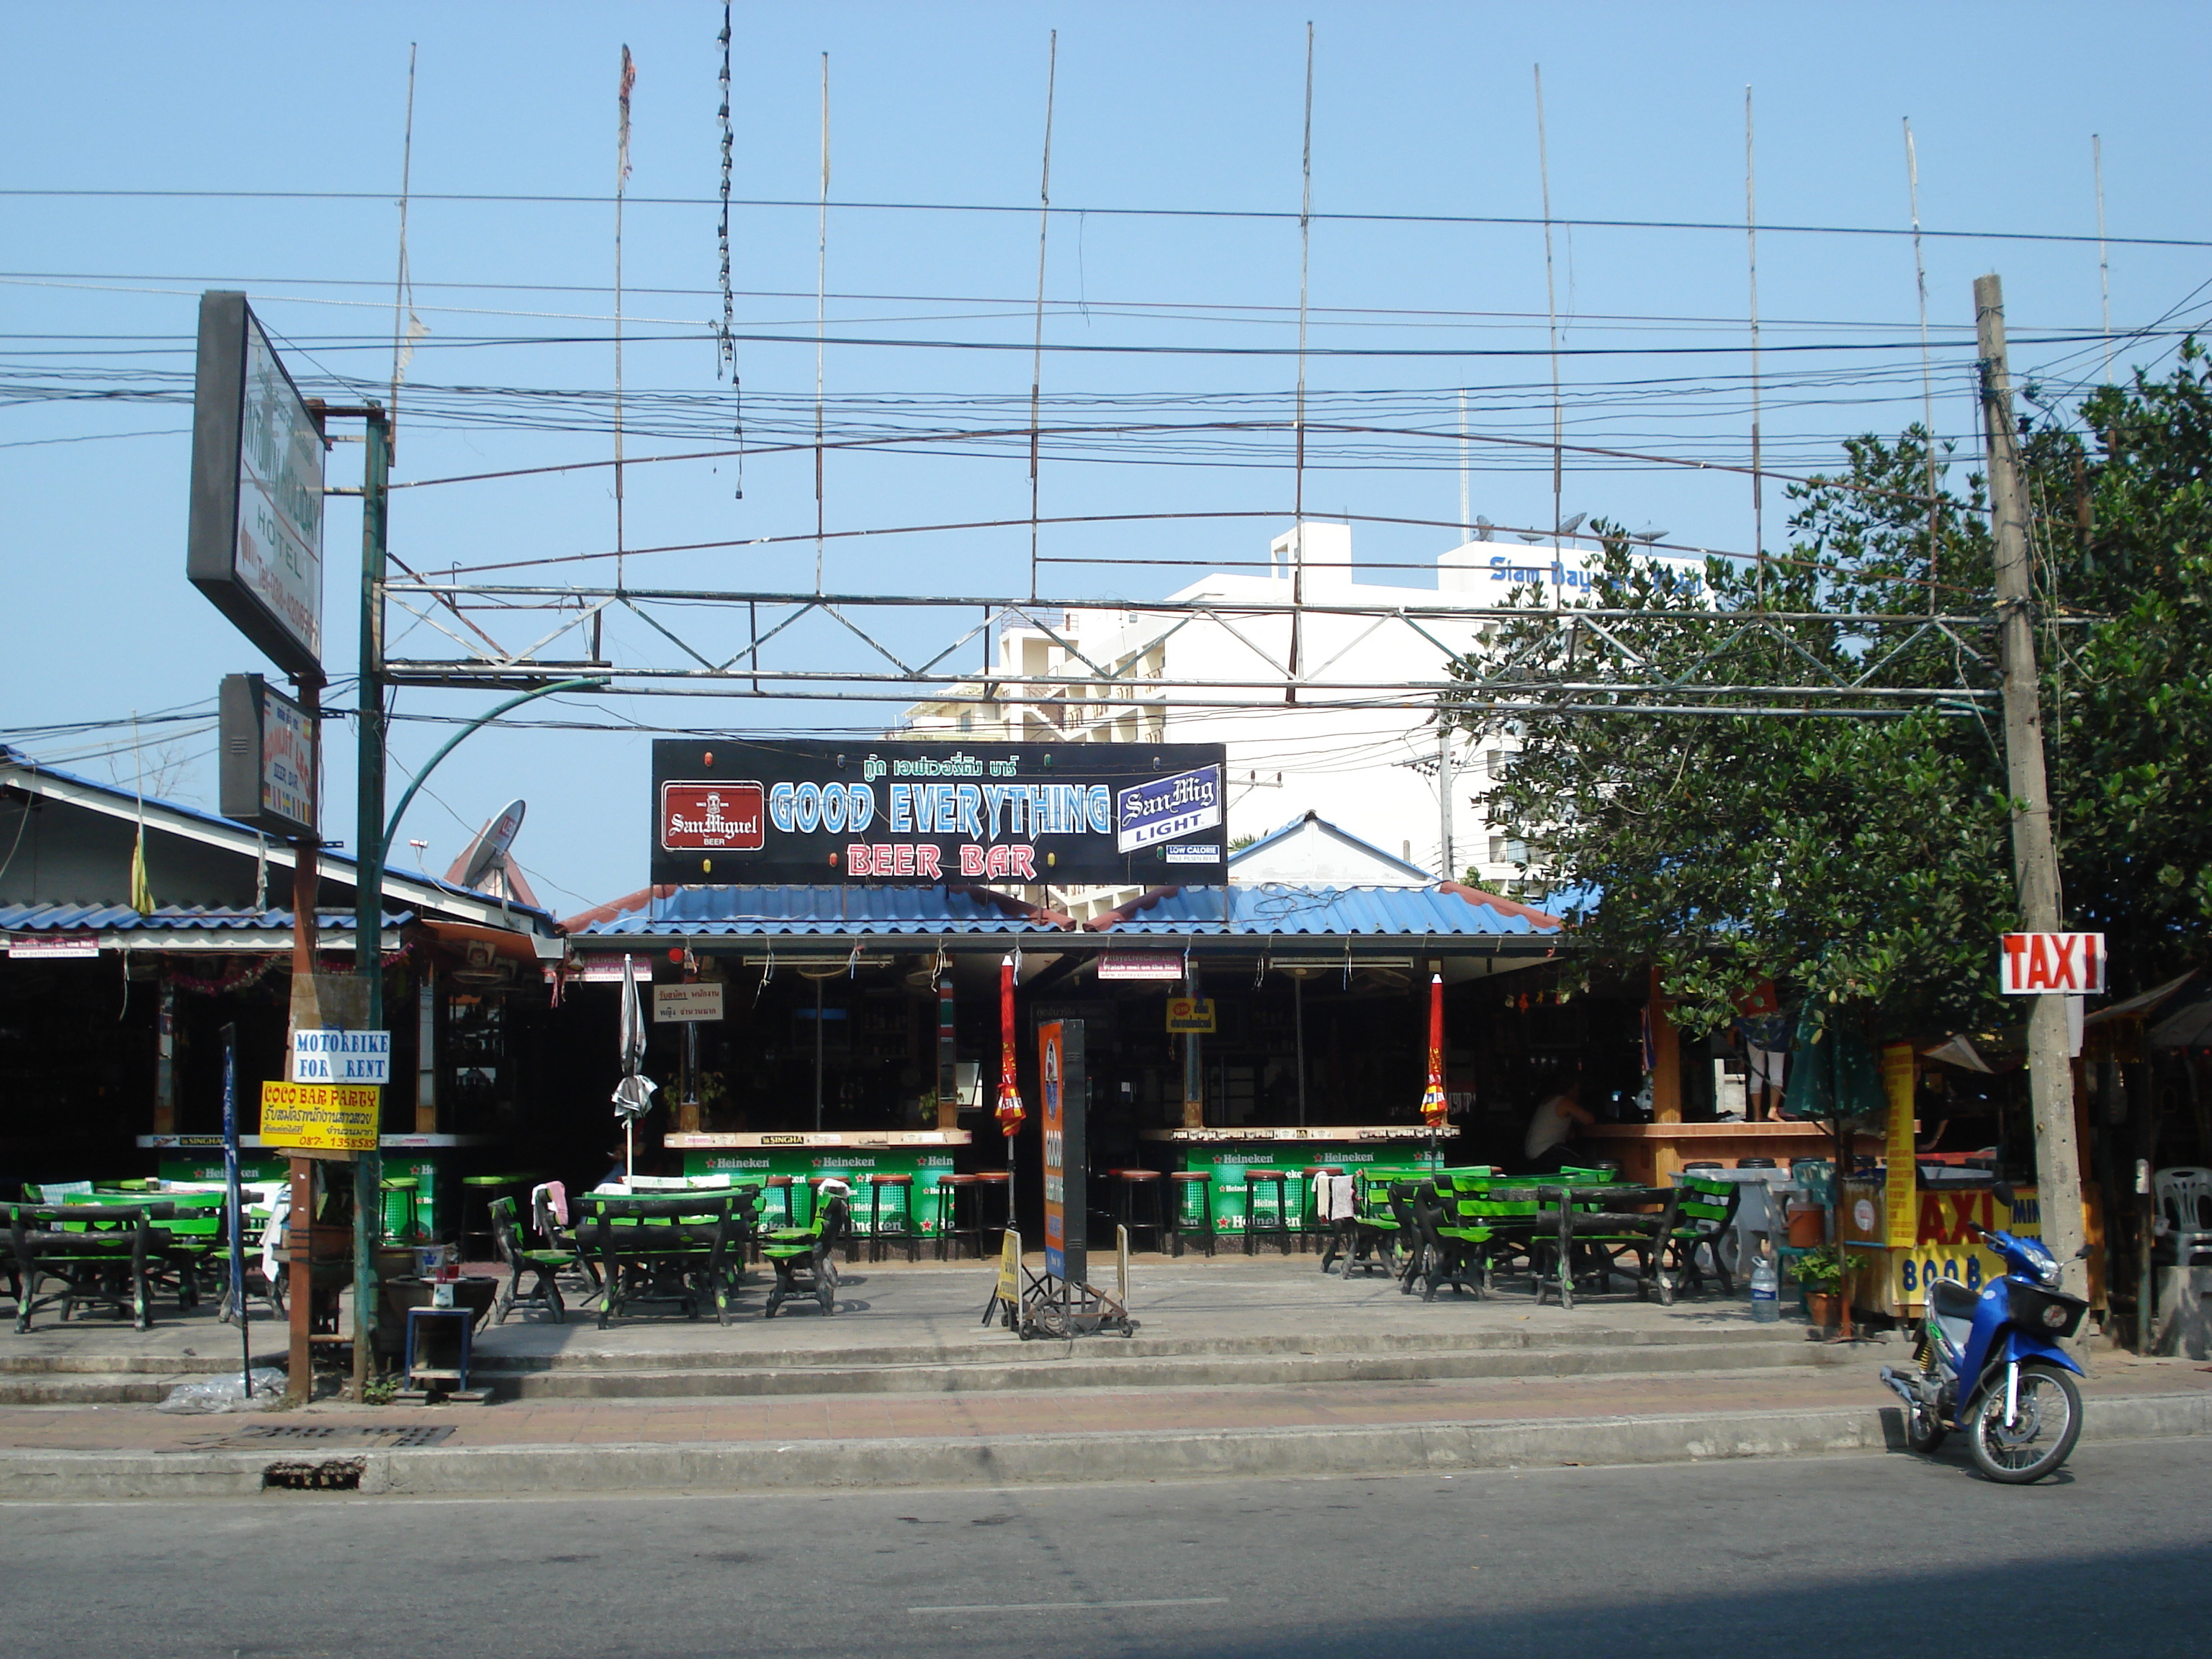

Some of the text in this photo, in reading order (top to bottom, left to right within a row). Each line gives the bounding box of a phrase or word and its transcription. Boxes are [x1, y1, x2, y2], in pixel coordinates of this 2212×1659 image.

[257, 503, 302, 580] HOTEL
[1489, 556, 1540, 584] Siam
[989, 755, 1020, 777] บาร์
[770, 781, 1112, 842] GOOD EVERYTHING
[1136, 814, 1202, 842] LIGHT
[847, 843, 1038, 881] BEER BAR
[2003, 935, 2098, 989] TAXI
[296, 1033, 389, 1053] MOTORBIKE
[298, 1058, 385, 1078] FOR RENT
[264, 1085, 377, 1107] COCO BAR PARTY
[770, 1136, 803, 1145] SINGHA
[717, 1158, 770, 1169] Heineken
[823, 1156, 875, 1167] Heineken
[1224, 1154, 1274, 1164] Heineken
[1324, 1152, 1374, 1163] Heineken
